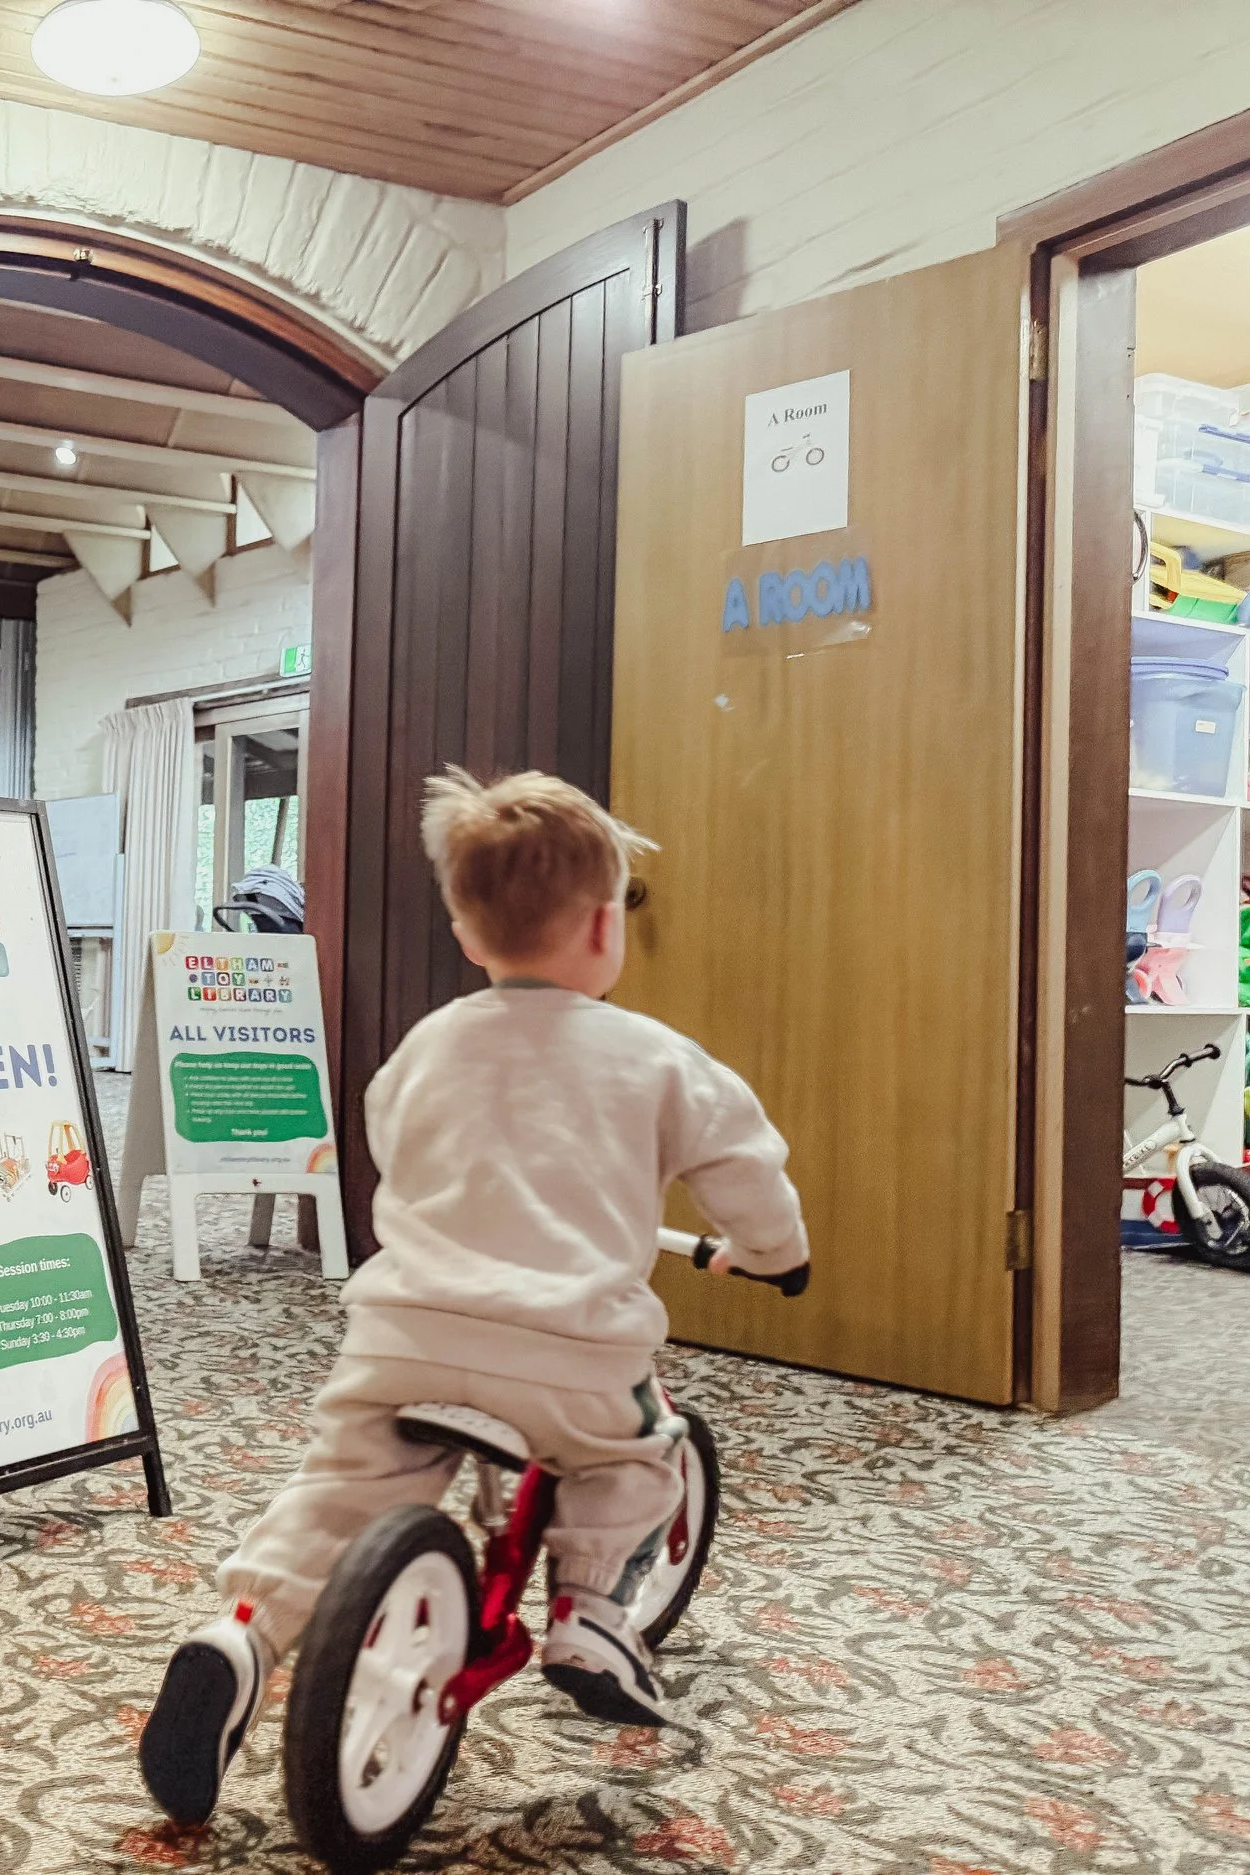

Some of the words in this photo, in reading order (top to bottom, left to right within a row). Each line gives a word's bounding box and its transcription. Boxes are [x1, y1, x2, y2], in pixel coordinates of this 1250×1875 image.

[767, 412, 779, 427] A
[784, 403, 827, 423] Room
[722, 577, 750, 633] A
[759, 555, 870, 626] ROOM
[185, 955, 274, 971] ELTHAM
[202, 972, 246, 986] TOY
[188, 987, 293, 1003] LIBRARY
[170, 1026, 207, 1041] ALL
[213, 1027, 315, 1043] VISITORS
[40, 1258, 70, 1271] times:
[31, 1295, 52, 1308] 10:00
[36, 1313, 54, 1324] 7:00
[0, 1336, 31, 1350] Sunday
